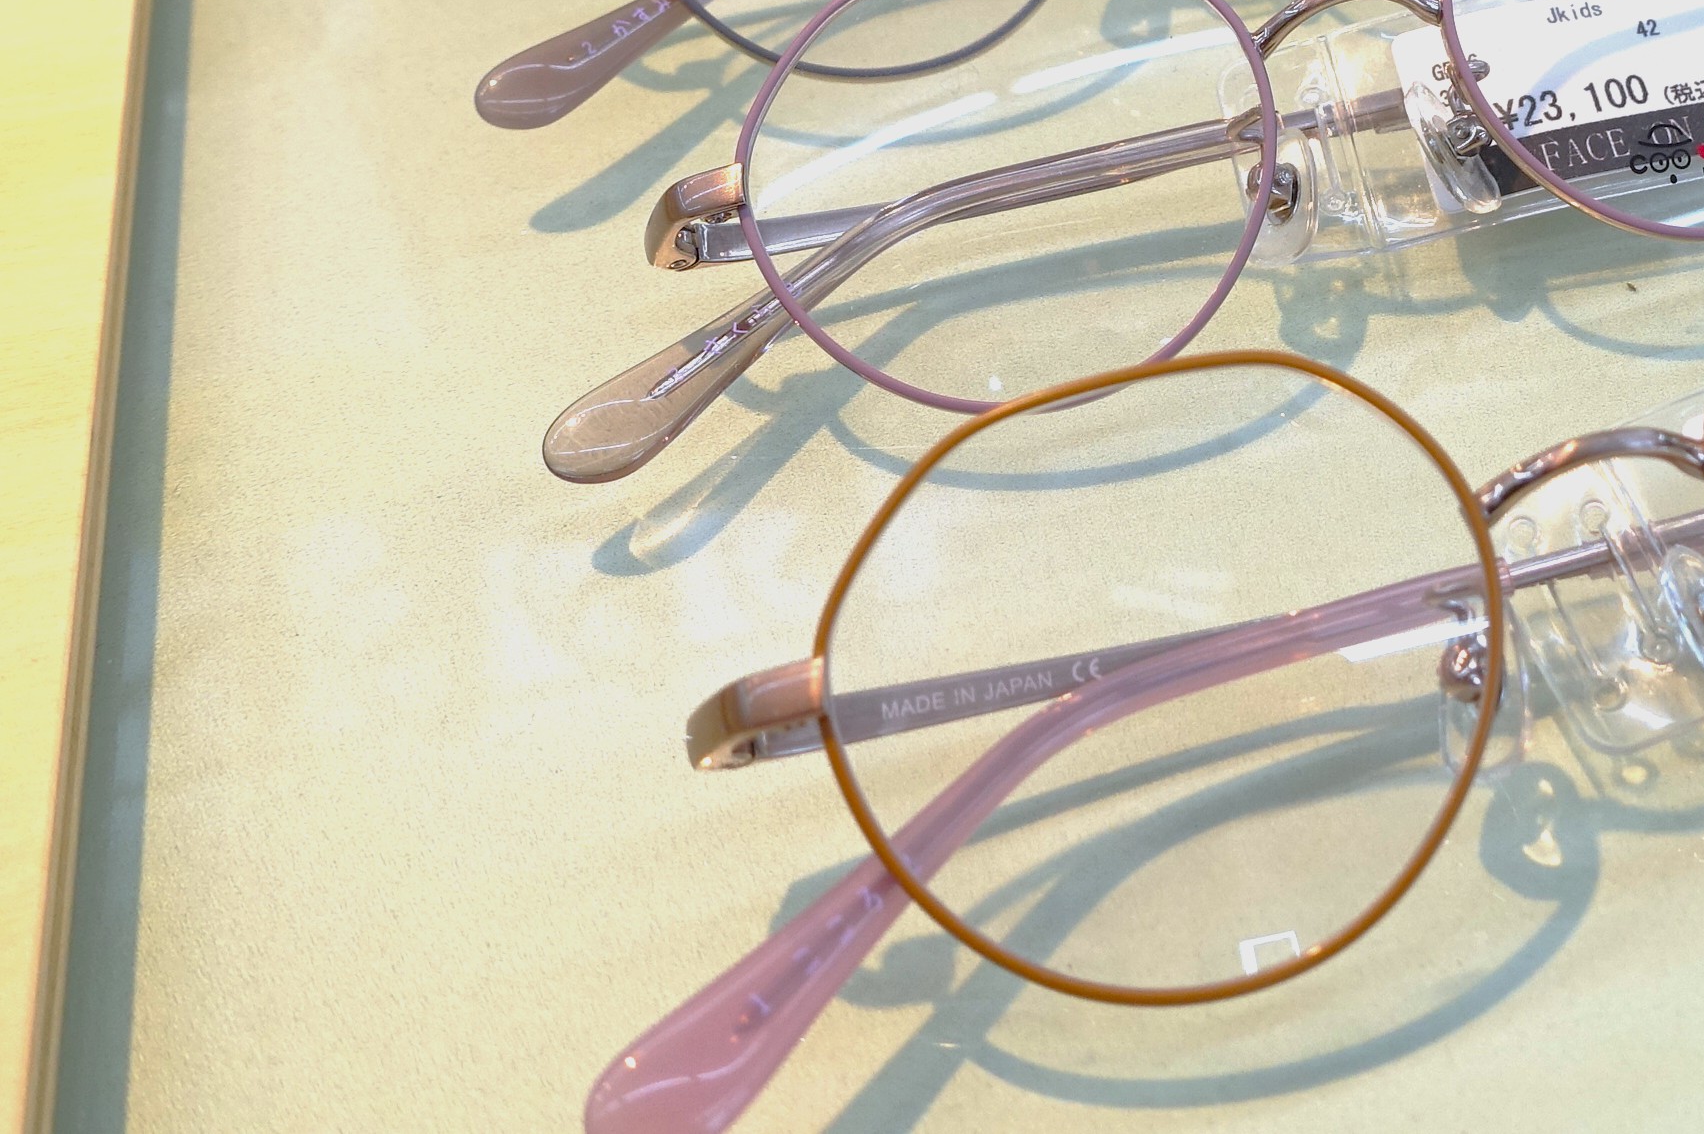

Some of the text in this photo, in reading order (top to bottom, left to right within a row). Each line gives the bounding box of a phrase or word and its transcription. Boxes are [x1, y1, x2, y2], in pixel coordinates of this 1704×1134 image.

[1546, 2, 1661, 38] Jkids 42
[1494, 74, 1650, 132] ¥23,100
[1539, 115, 1693, 172] FACE ON
[881, 690, 945, 720] MADE
[954, 684, 976, 706] IN
[983, 670, 1053, 702] JAPAN
